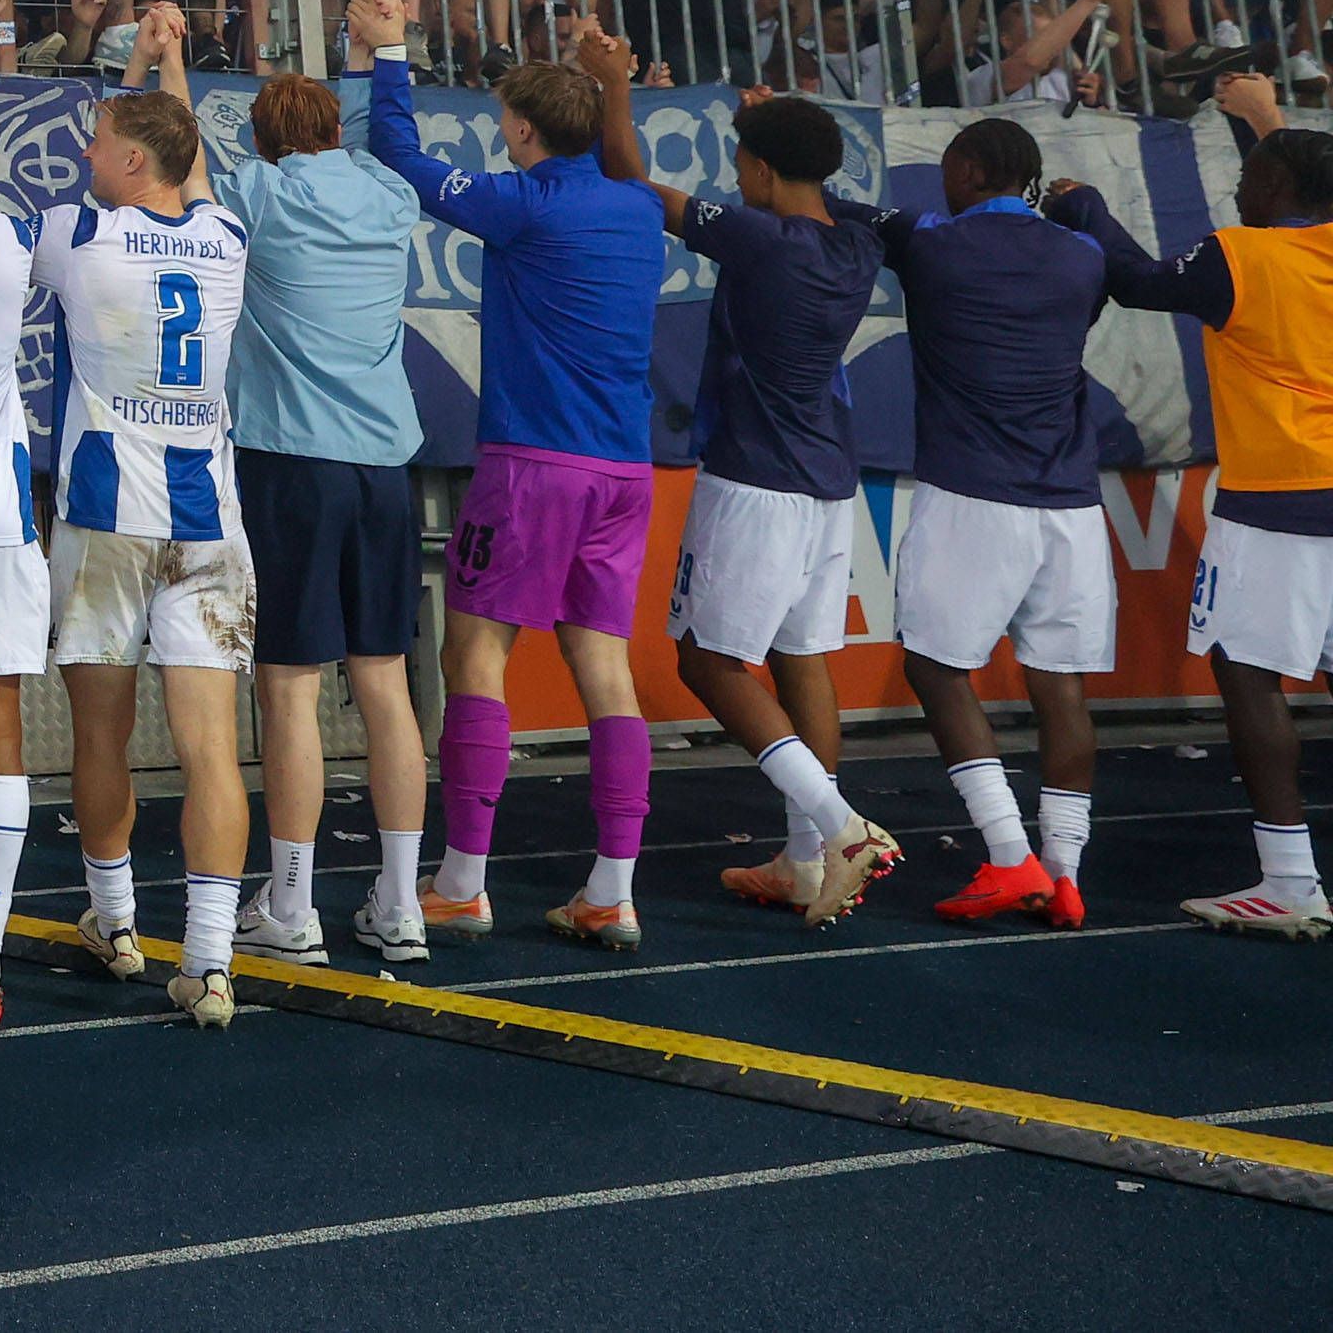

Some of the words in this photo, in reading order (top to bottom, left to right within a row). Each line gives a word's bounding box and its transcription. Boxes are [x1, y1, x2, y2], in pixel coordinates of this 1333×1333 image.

[123, 231, 194, 258] HERTHA
[195, 239, 226, 260] BSC
[153, 268, 207, 392] 2
[457, 521, 495, 571] 43
[1191, 558, 1218, 612] 21
[286, 850, 300, 889] CASTORE
